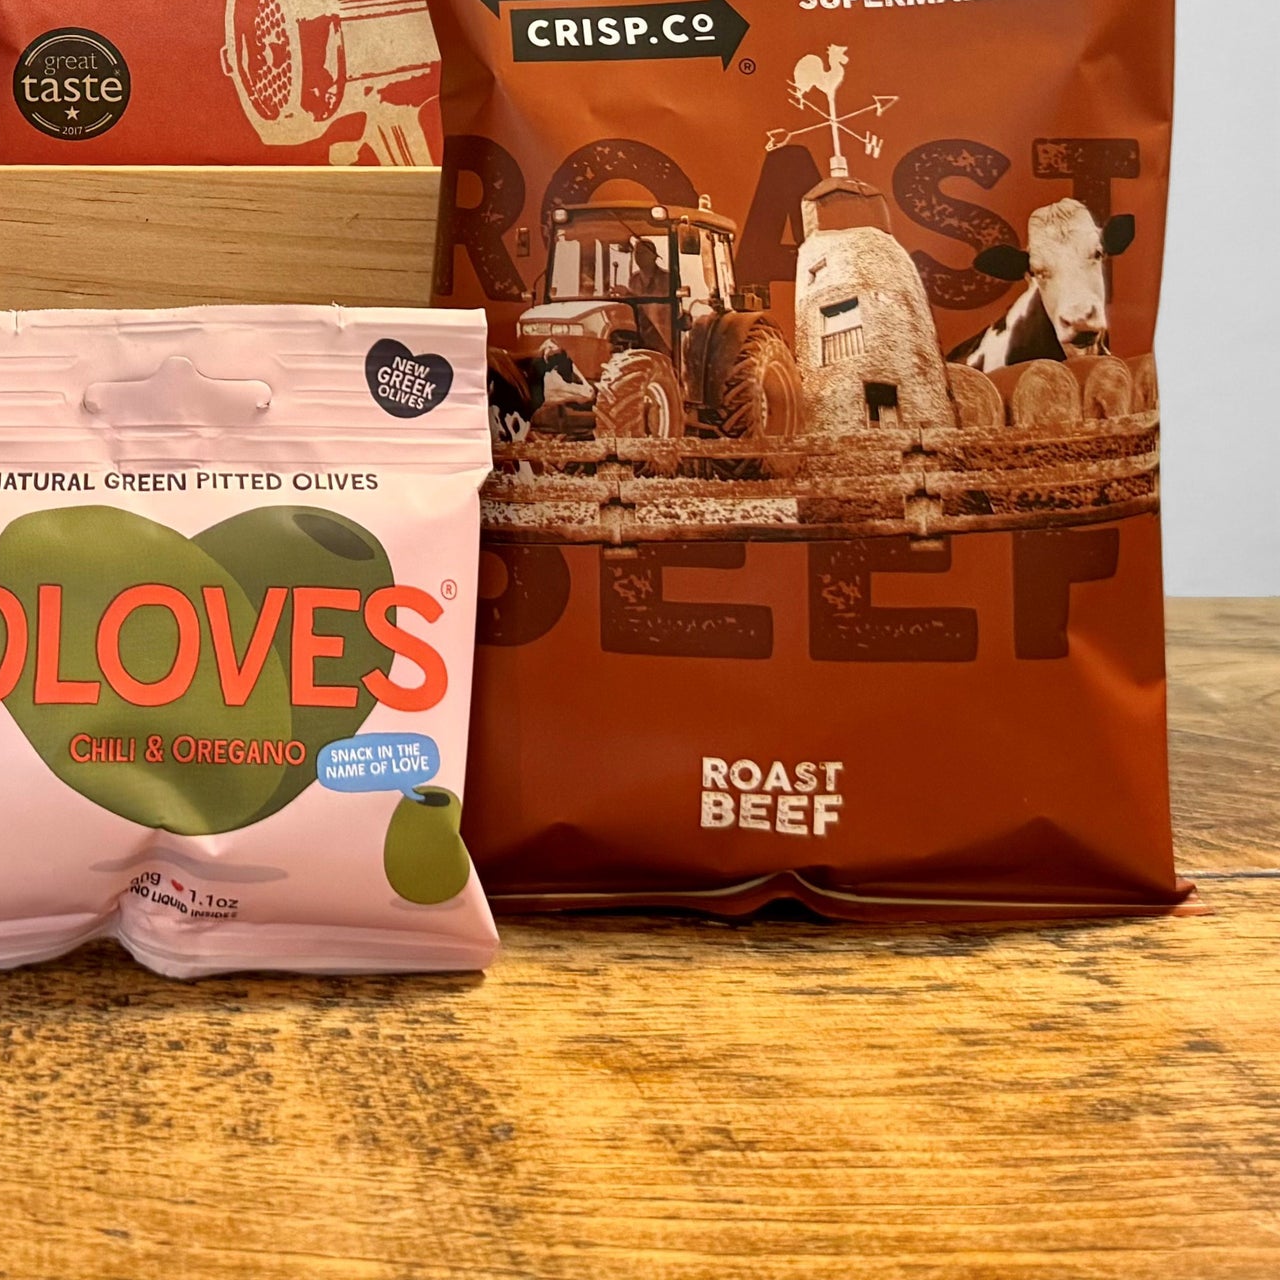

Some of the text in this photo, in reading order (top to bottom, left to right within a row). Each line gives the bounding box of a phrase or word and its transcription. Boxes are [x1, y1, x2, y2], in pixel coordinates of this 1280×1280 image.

[43, 52, 99, 76] great
[21, 73, 123, 103] taste
[62, 126, 83, 136] 2017
[392, 356, 430, 379] NEW
[377, 366, 437, 400] GREEK
[378, 384, 425, 410] OLIVES
[104, 472, 187, 493] GREEN
[196, 471, 282, 491] PITTED
[292, 471, 379, 491] OLIVES
[69, 732, 307, 767] CHILI & OREGANO
[330, 742, 420, 763] SNACK IN THE
[326, 755, 430, 779] NAME OF LOVE
[701, 755, 844, 793] ROAST
[700, 790, 844, 836] BEEF
[130, 884, 150, 898] NO
[151, 891, 188, 914] LIQUID
